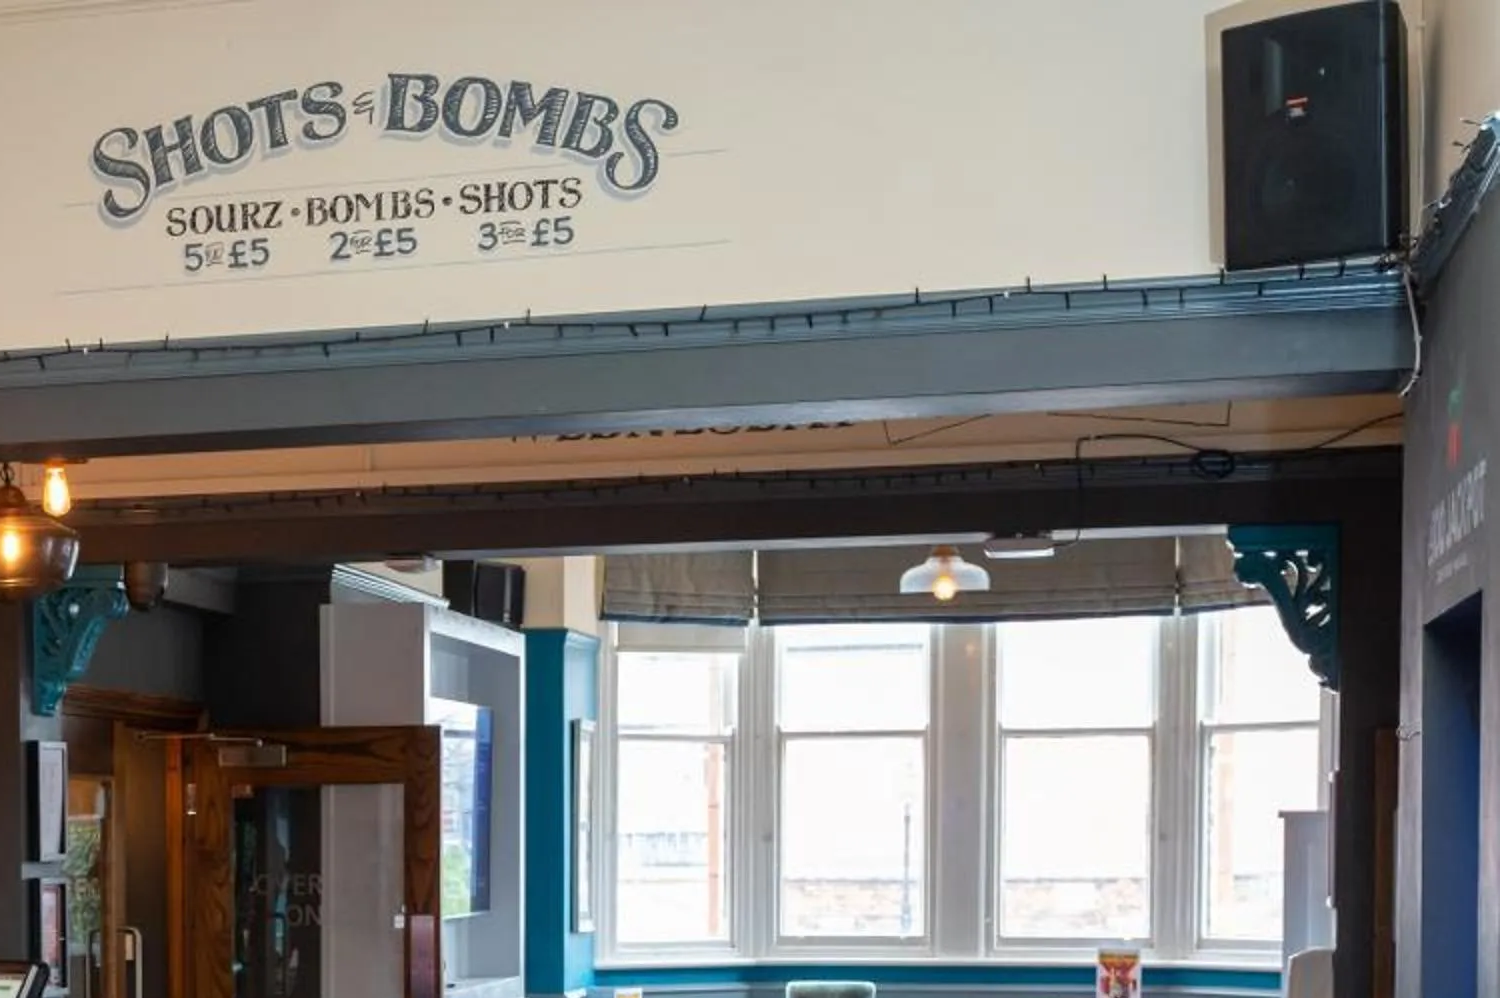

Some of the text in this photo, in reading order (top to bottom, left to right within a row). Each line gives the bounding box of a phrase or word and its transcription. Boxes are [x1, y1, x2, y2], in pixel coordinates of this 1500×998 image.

[92, 80, 348, 220] SHOTS
[386, 72, 680, 191] BOMBS
[165, 176, 583, 238] SOURZ BOMBS SHOTS
[329, 231, 352, 260] 2
[373, 226, 418, 257] £5
[477, 222, 499, 251] 3
[530, 214, 575, 247] £5
[185, 242, 204, 272] 5
[227, 237, 270, 268] £5
